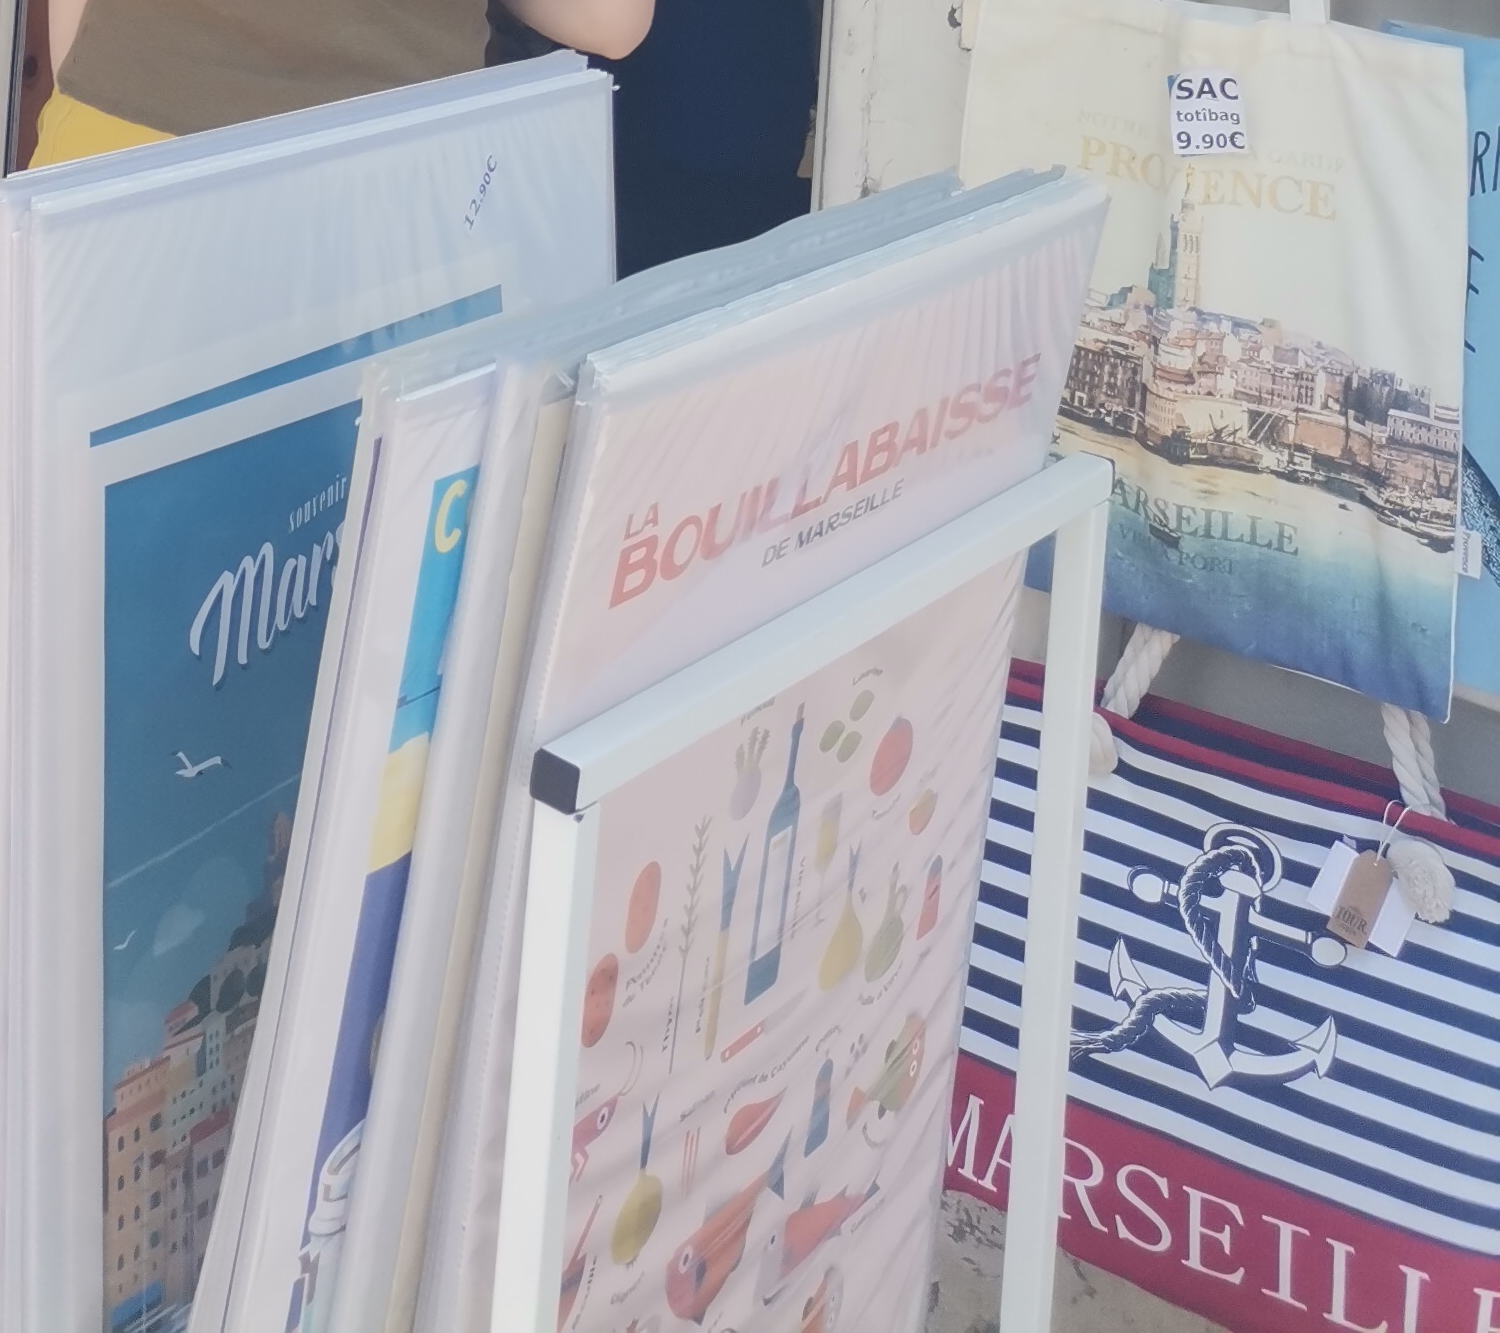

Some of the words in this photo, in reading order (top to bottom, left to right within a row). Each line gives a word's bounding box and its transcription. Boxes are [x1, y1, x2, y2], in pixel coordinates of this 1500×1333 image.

[1175, 75, 1240, 101] SAC
[1076, 134, 1338, 222] PROVENCE
[1176, 129, 1246, 153] 9.90€
[463, 153, 499, 232] 12.90€
[608, 352, 1042, 610] BOUILLABAISSE
[623, 501, 660, 542] LA
[761, 535, 792, 569] DE
[793, 477, 905, 553] MARSEILLE
